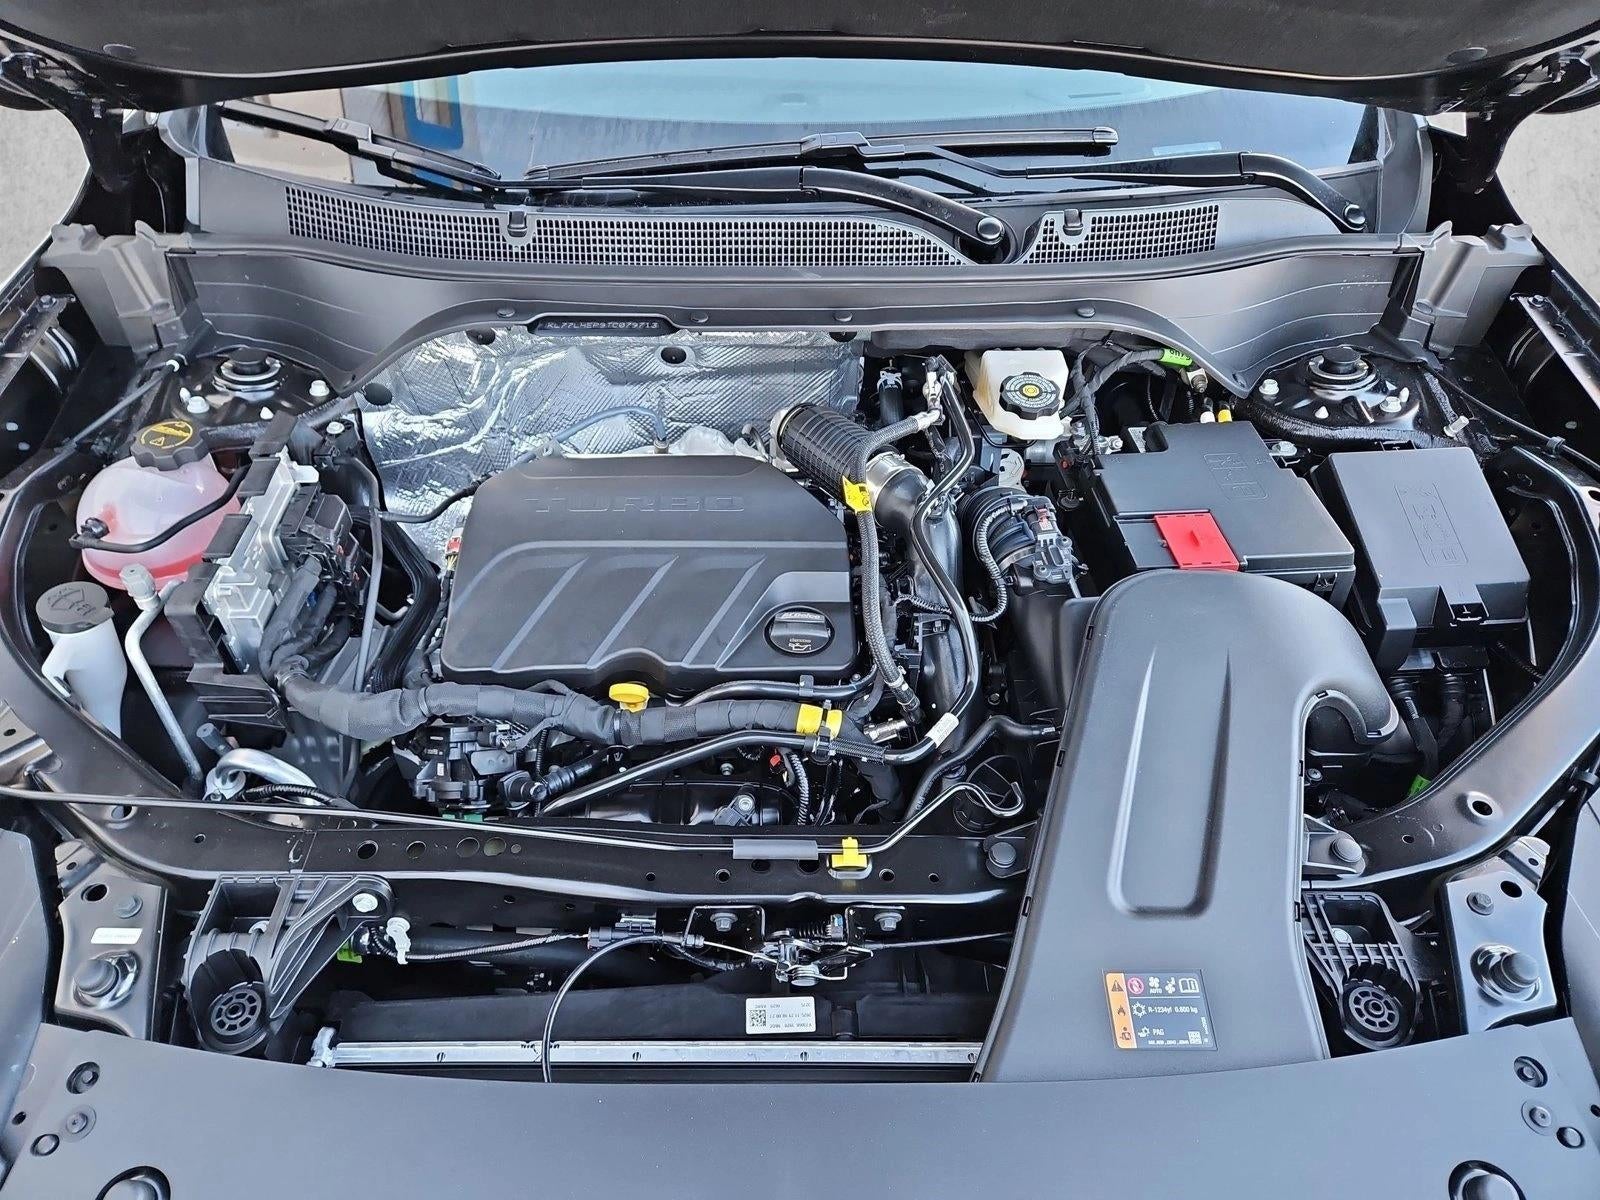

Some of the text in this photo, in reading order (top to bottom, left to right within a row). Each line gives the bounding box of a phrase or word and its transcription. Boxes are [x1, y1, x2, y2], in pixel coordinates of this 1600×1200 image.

[546, 321, 659, 329] KL77LHEP9TC079713
[523, 497, 745, 512] TURBO
[1190, 1006, 1199, 1014] kg
